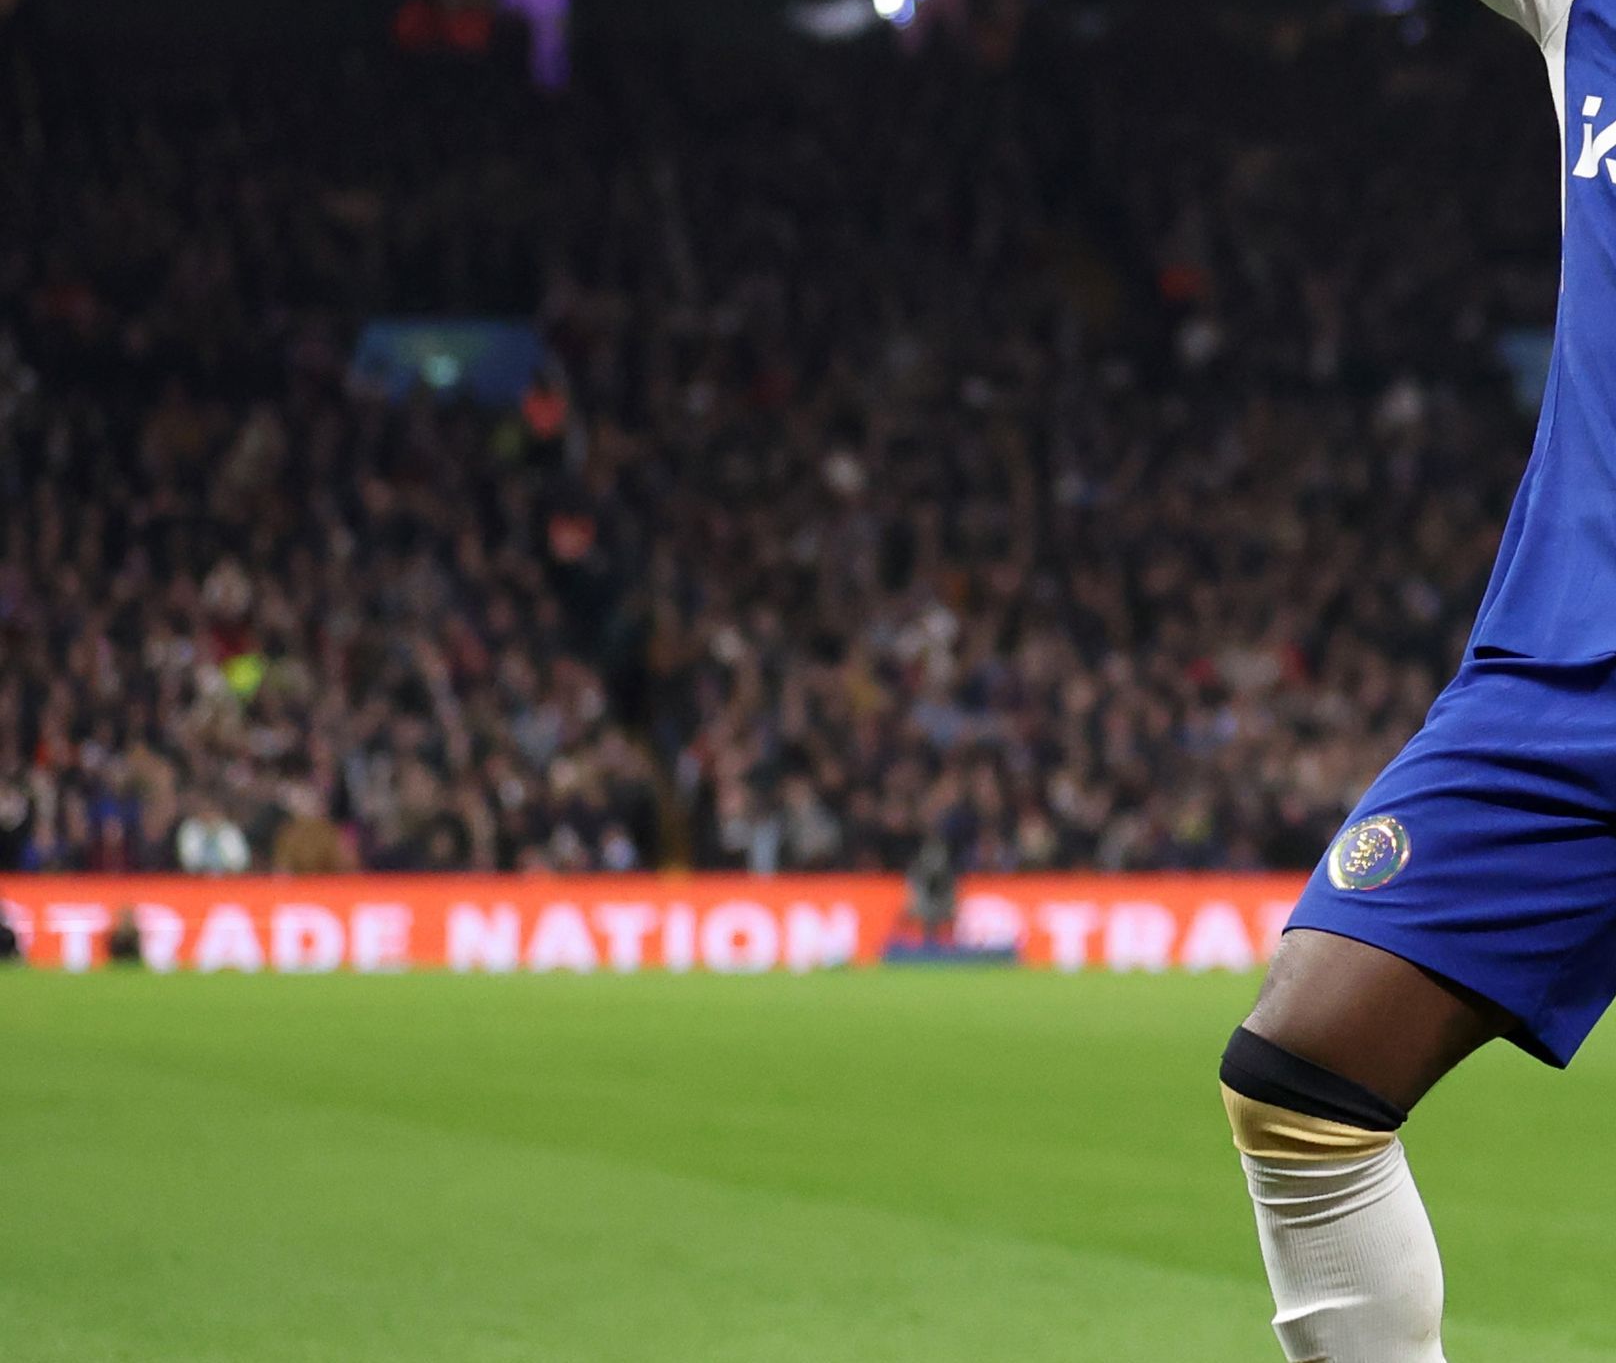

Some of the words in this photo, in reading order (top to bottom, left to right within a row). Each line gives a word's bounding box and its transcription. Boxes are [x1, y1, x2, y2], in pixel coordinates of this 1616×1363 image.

[44, 902, 412, 973] TRADE
[446, 901, 858, 973] NATION
[1037, 900, 1293, 973] TRA
